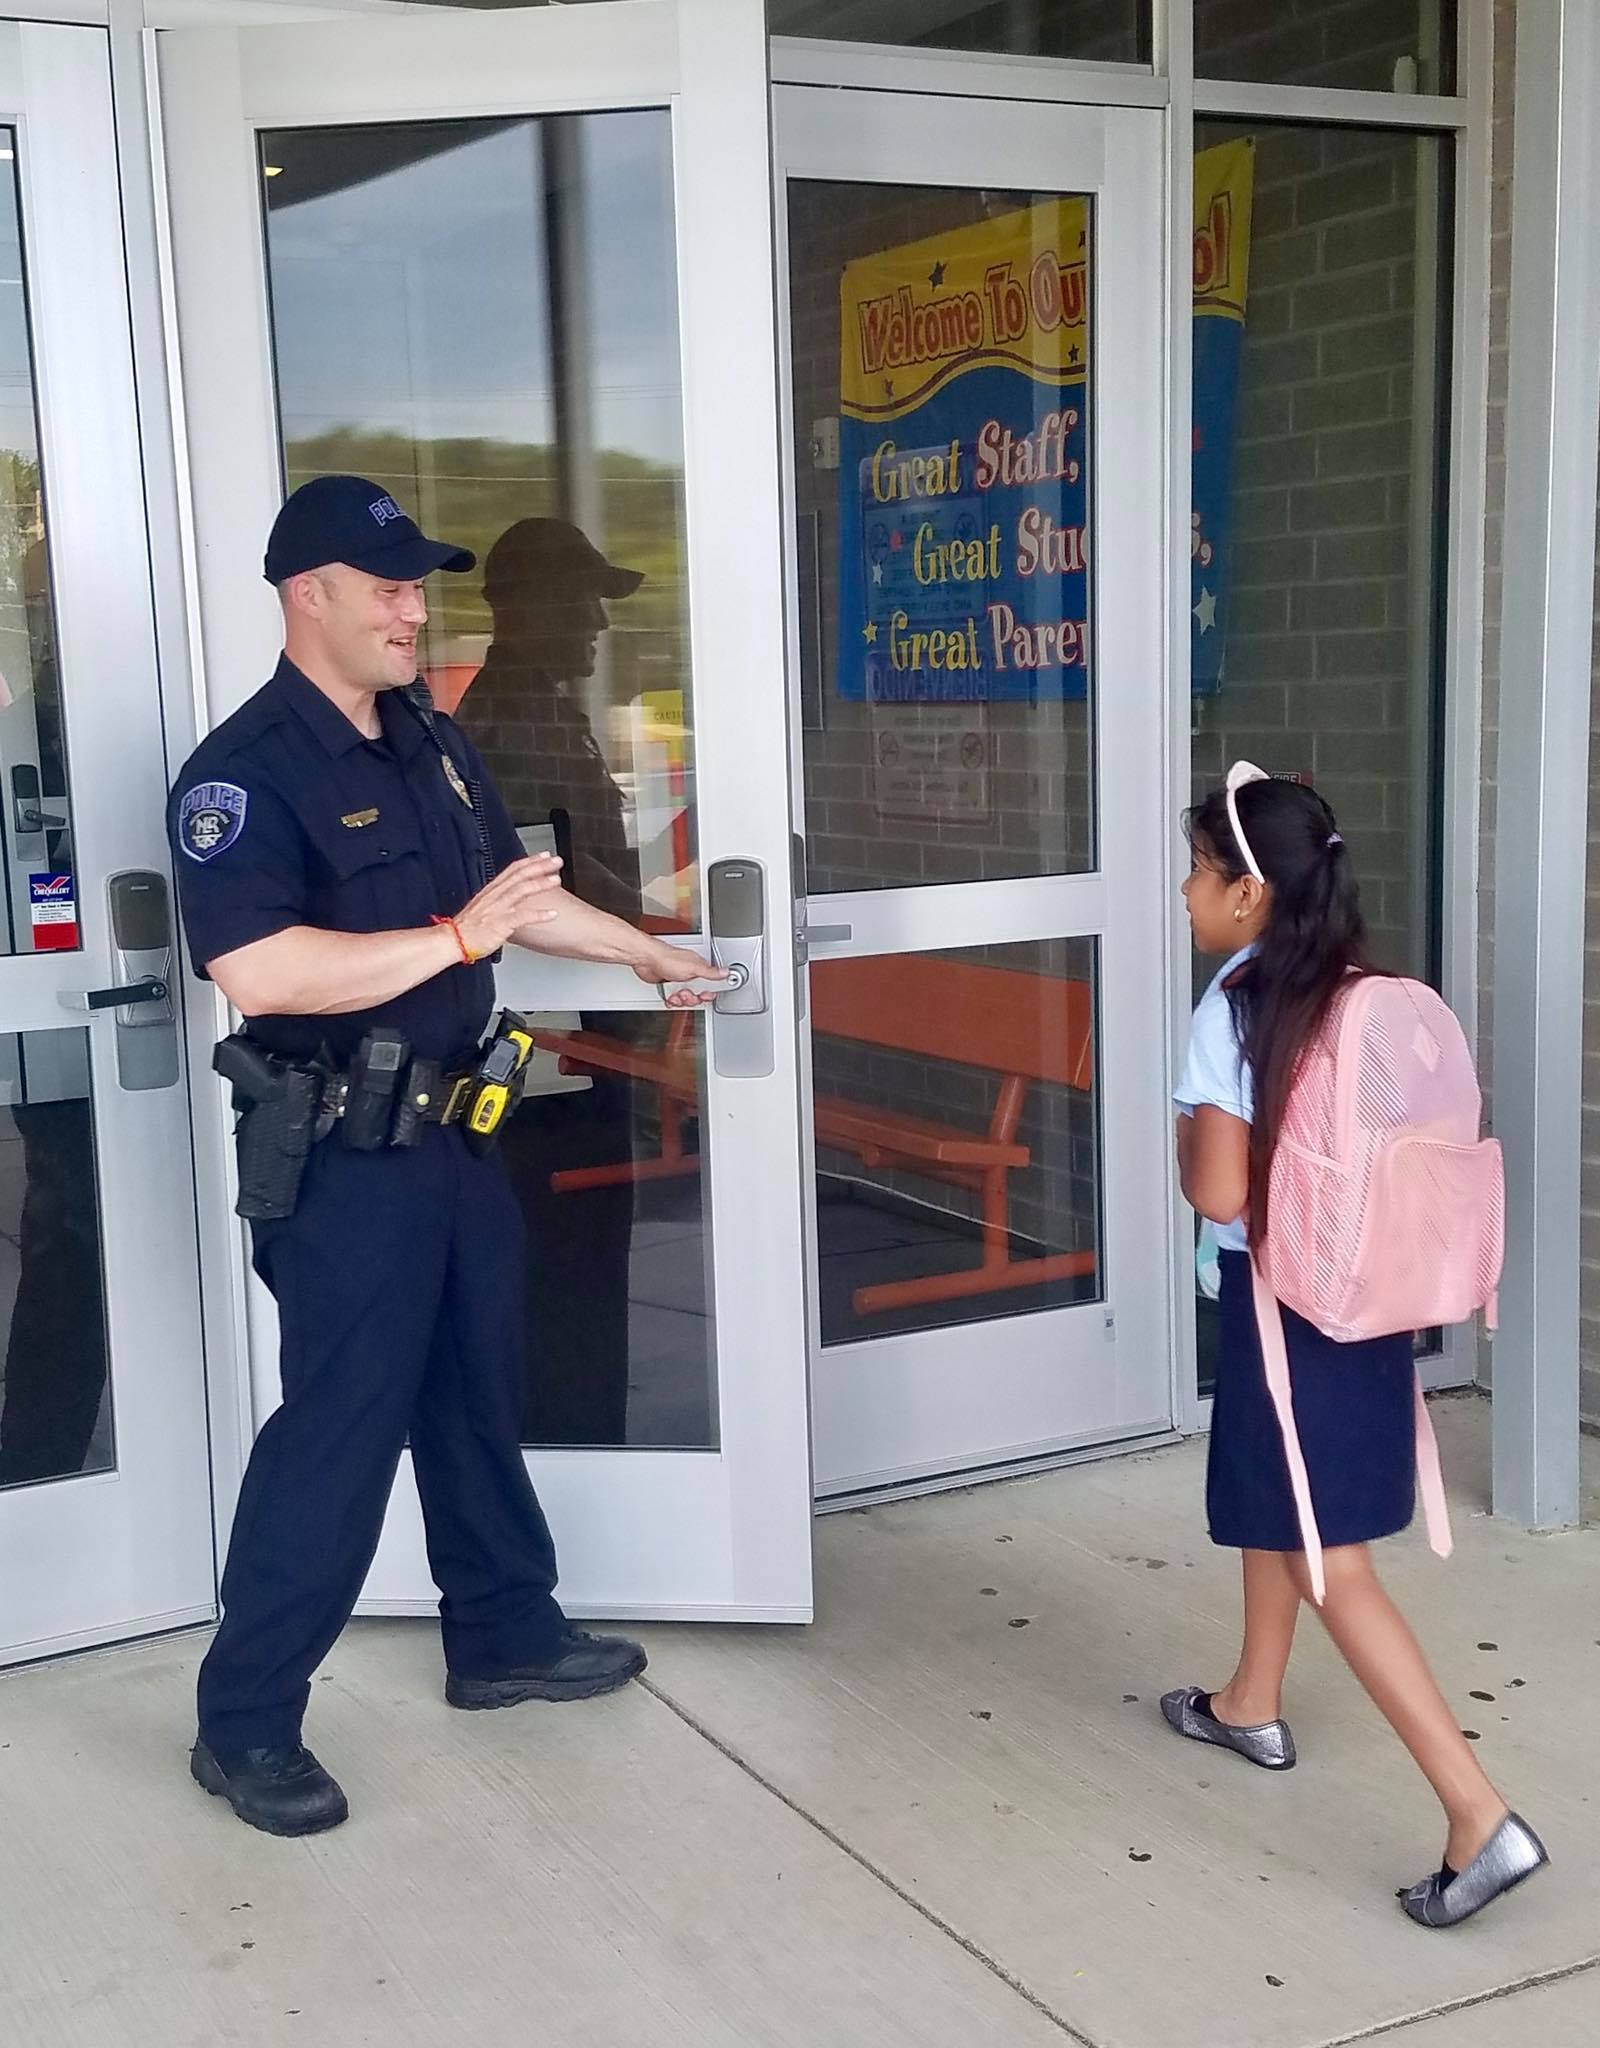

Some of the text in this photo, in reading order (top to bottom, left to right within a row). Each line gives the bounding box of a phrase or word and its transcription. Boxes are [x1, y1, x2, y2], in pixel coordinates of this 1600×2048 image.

[858, 250, 1087, 374] Welcome To Ou
[871, 409, 1080, 503] Great Staff,
[913, 521, 1003, 586] Great
[890, 610, 983, 672] Great
[182, 784, 243, 819] POLICE
